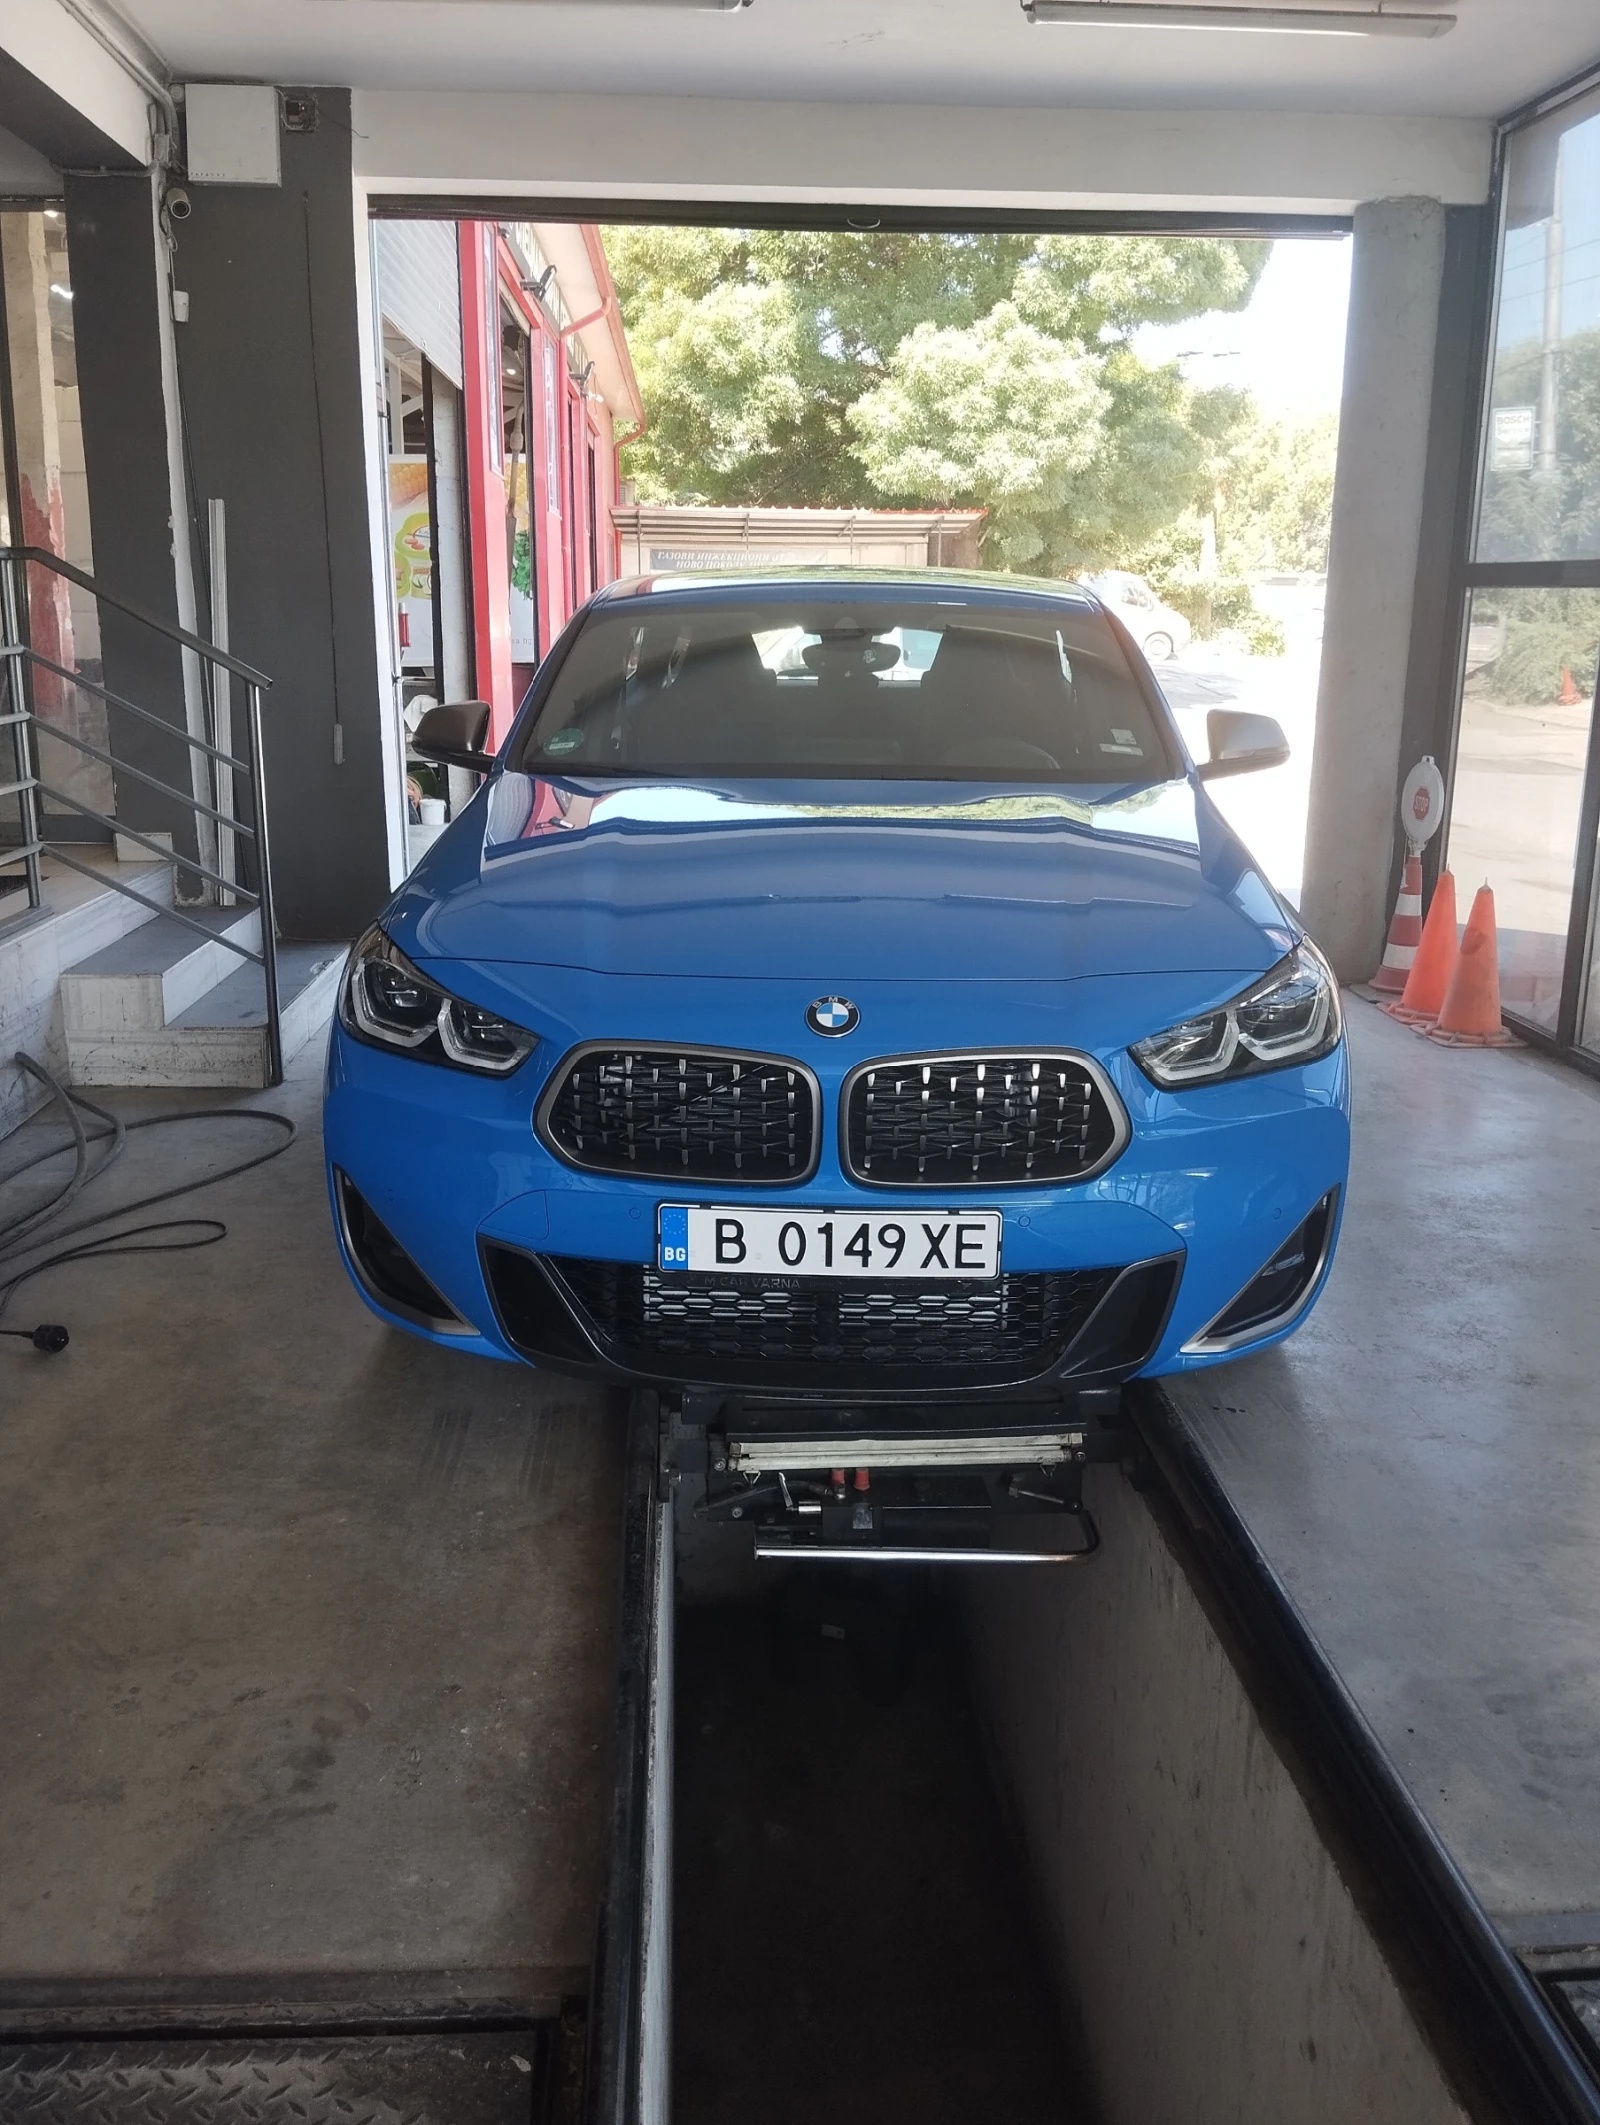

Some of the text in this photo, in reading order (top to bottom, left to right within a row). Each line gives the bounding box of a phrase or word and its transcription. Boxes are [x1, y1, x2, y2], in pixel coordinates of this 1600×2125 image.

[1414, 795, 1429, 812] STOP
[812, 996, 855, 1010] BMW
[715, 1217, 987, 1269] B 0149 XE
[664, 1246, 687, 1262] BG
[751, 1277, 802, 1290] VARNA
